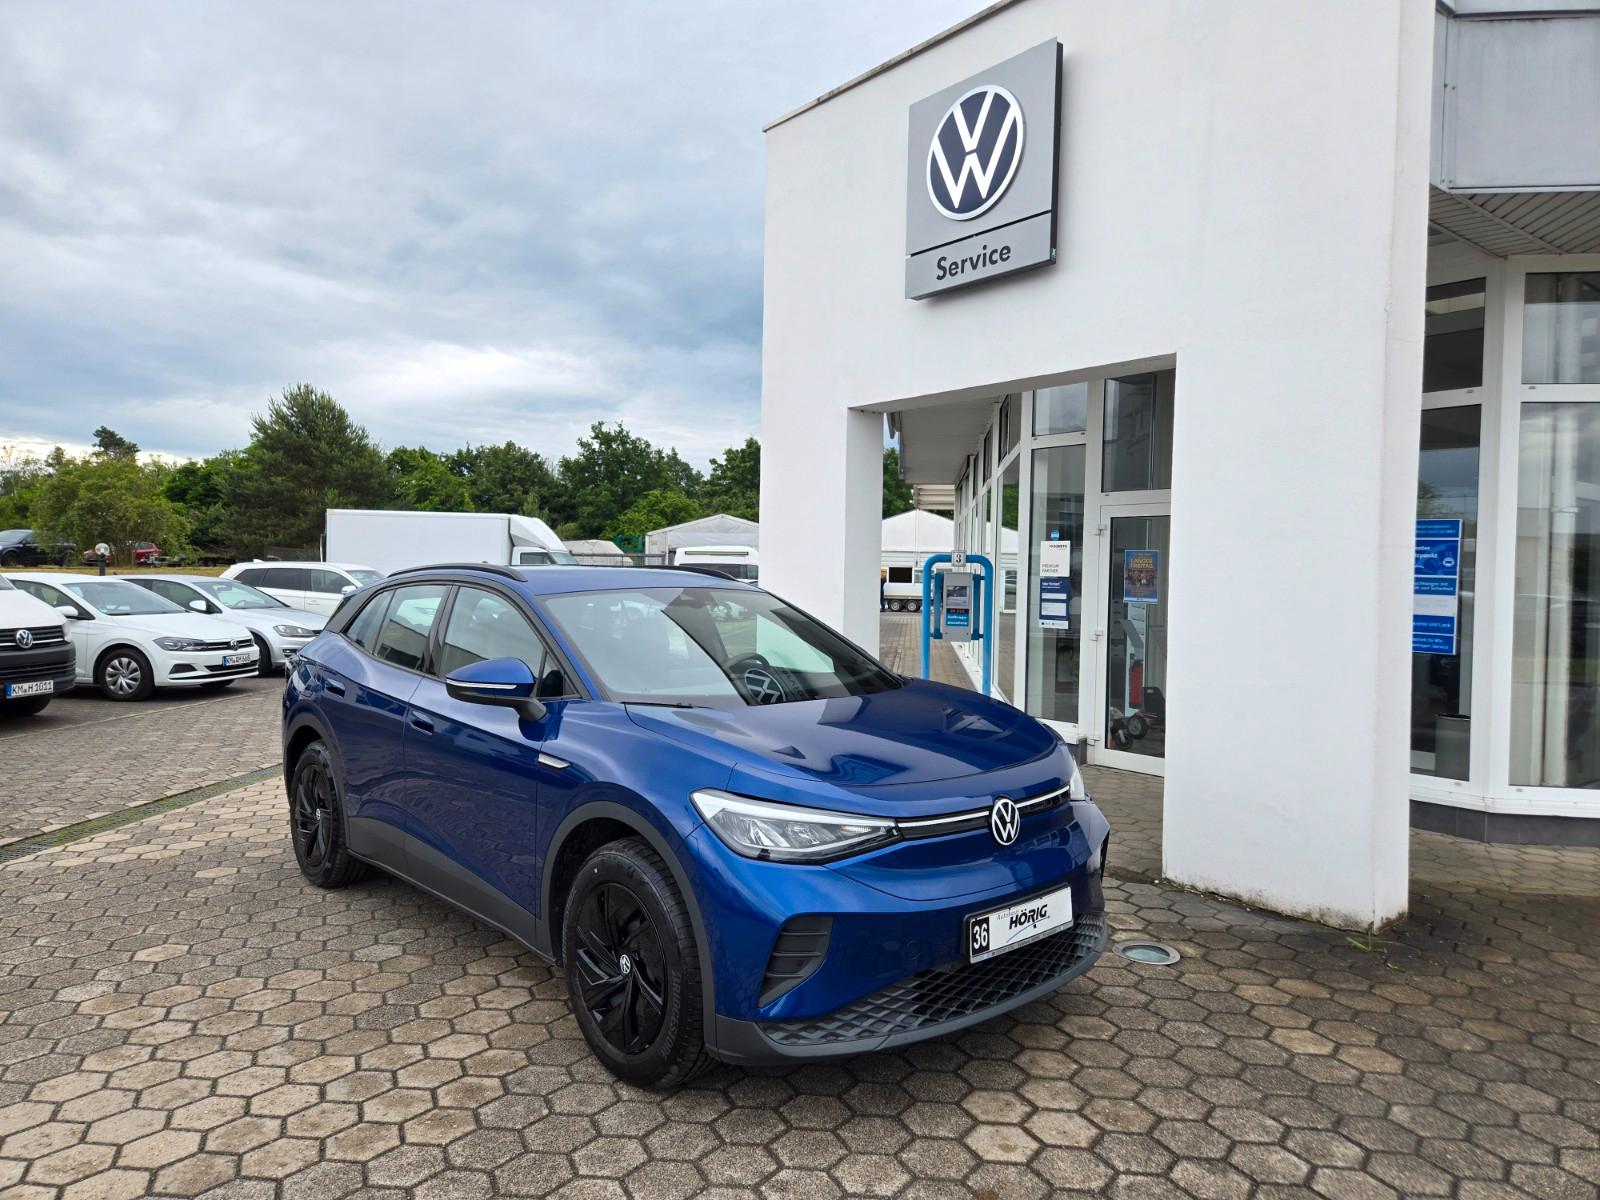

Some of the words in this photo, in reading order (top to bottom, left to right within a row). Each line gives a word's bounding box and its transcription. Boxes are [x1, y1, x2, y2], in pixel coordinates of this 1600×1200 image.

[928, 86, 1022, 216] VW
[936, 244, 1011, 280] Service
[955, 554, 962, 563] 3
[992, 800, 1020, 844] VW
[1009, 904, 1048, 929] HÖRIG
[973, 923, 988, 949] 36
